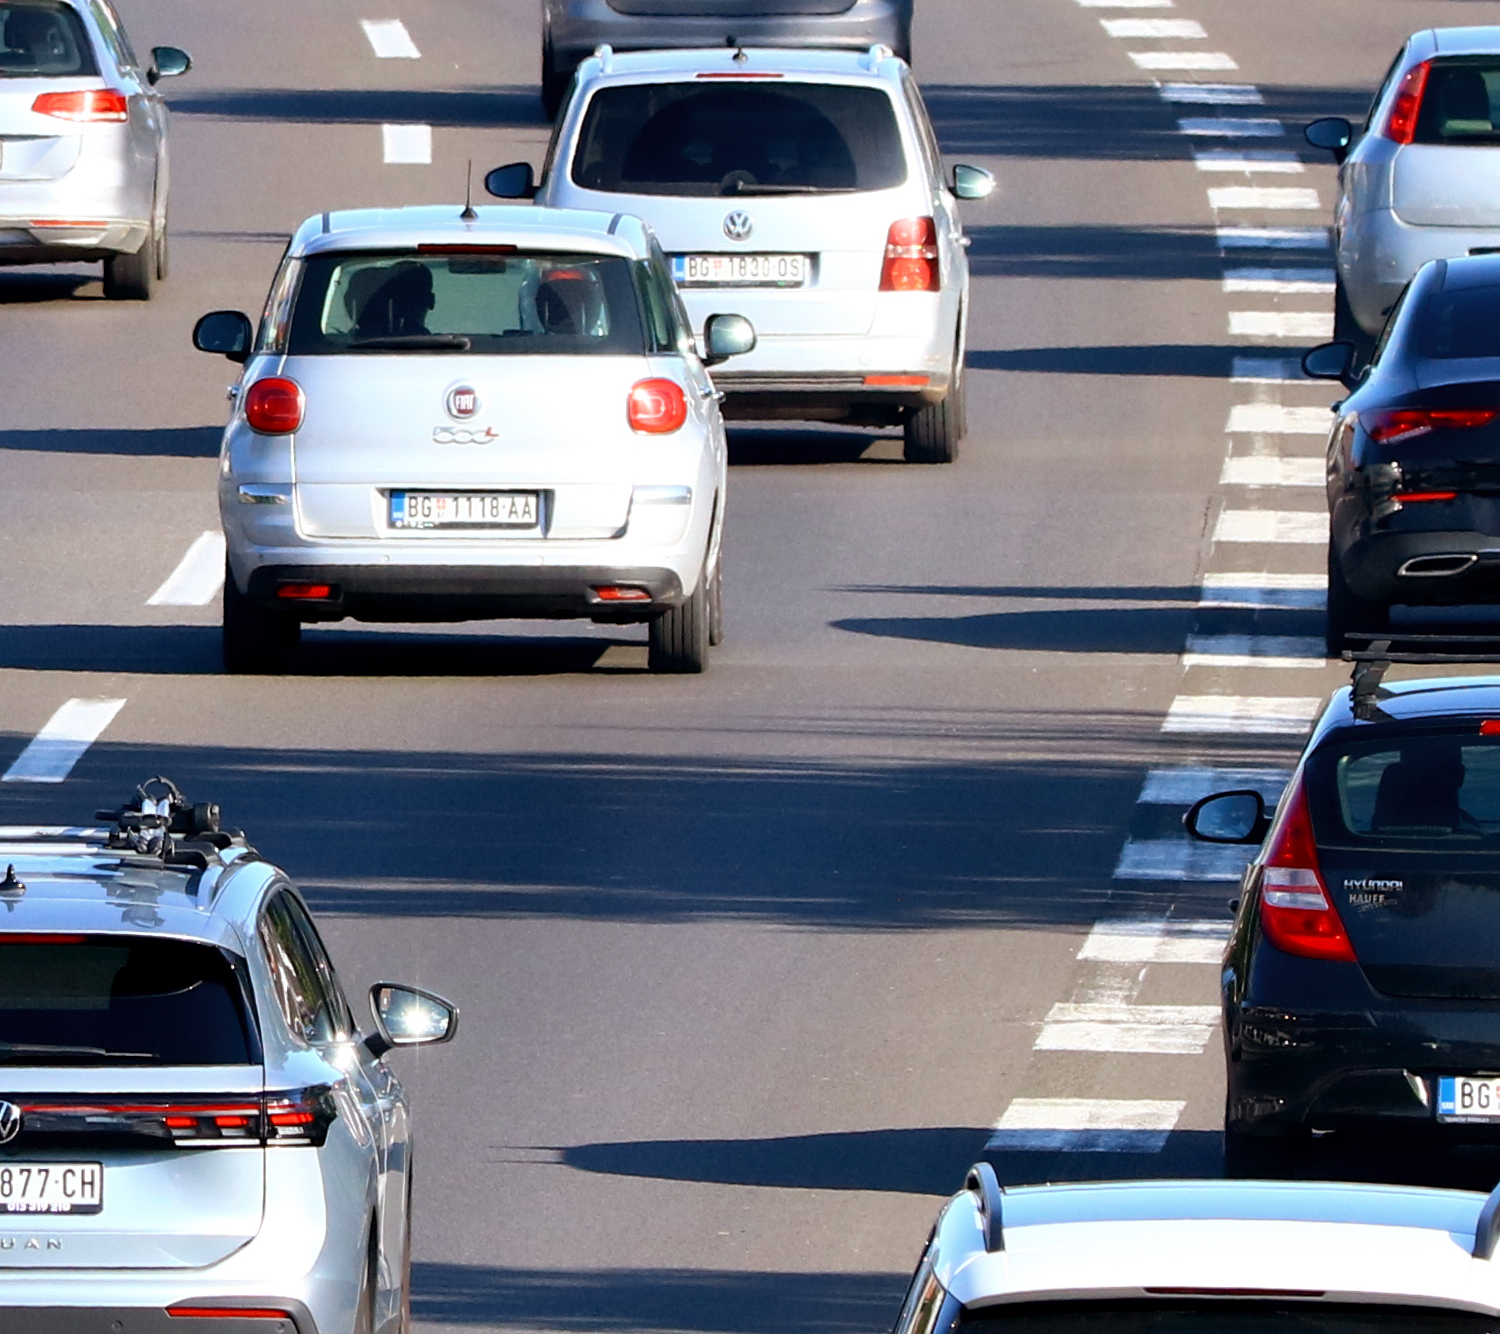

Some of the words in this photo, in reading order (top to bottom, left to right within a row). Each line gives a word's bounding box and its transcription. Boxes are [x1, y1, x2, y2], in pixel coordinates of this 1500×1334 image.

[688, 257, 710, 278] BG
[455, 394, 475, 410] FIAT
[408, 496, 432, 518] BG
[1343, 878, 1404, 892] HYUNDAI
[1460, 1082, 1491, 1110] BG
